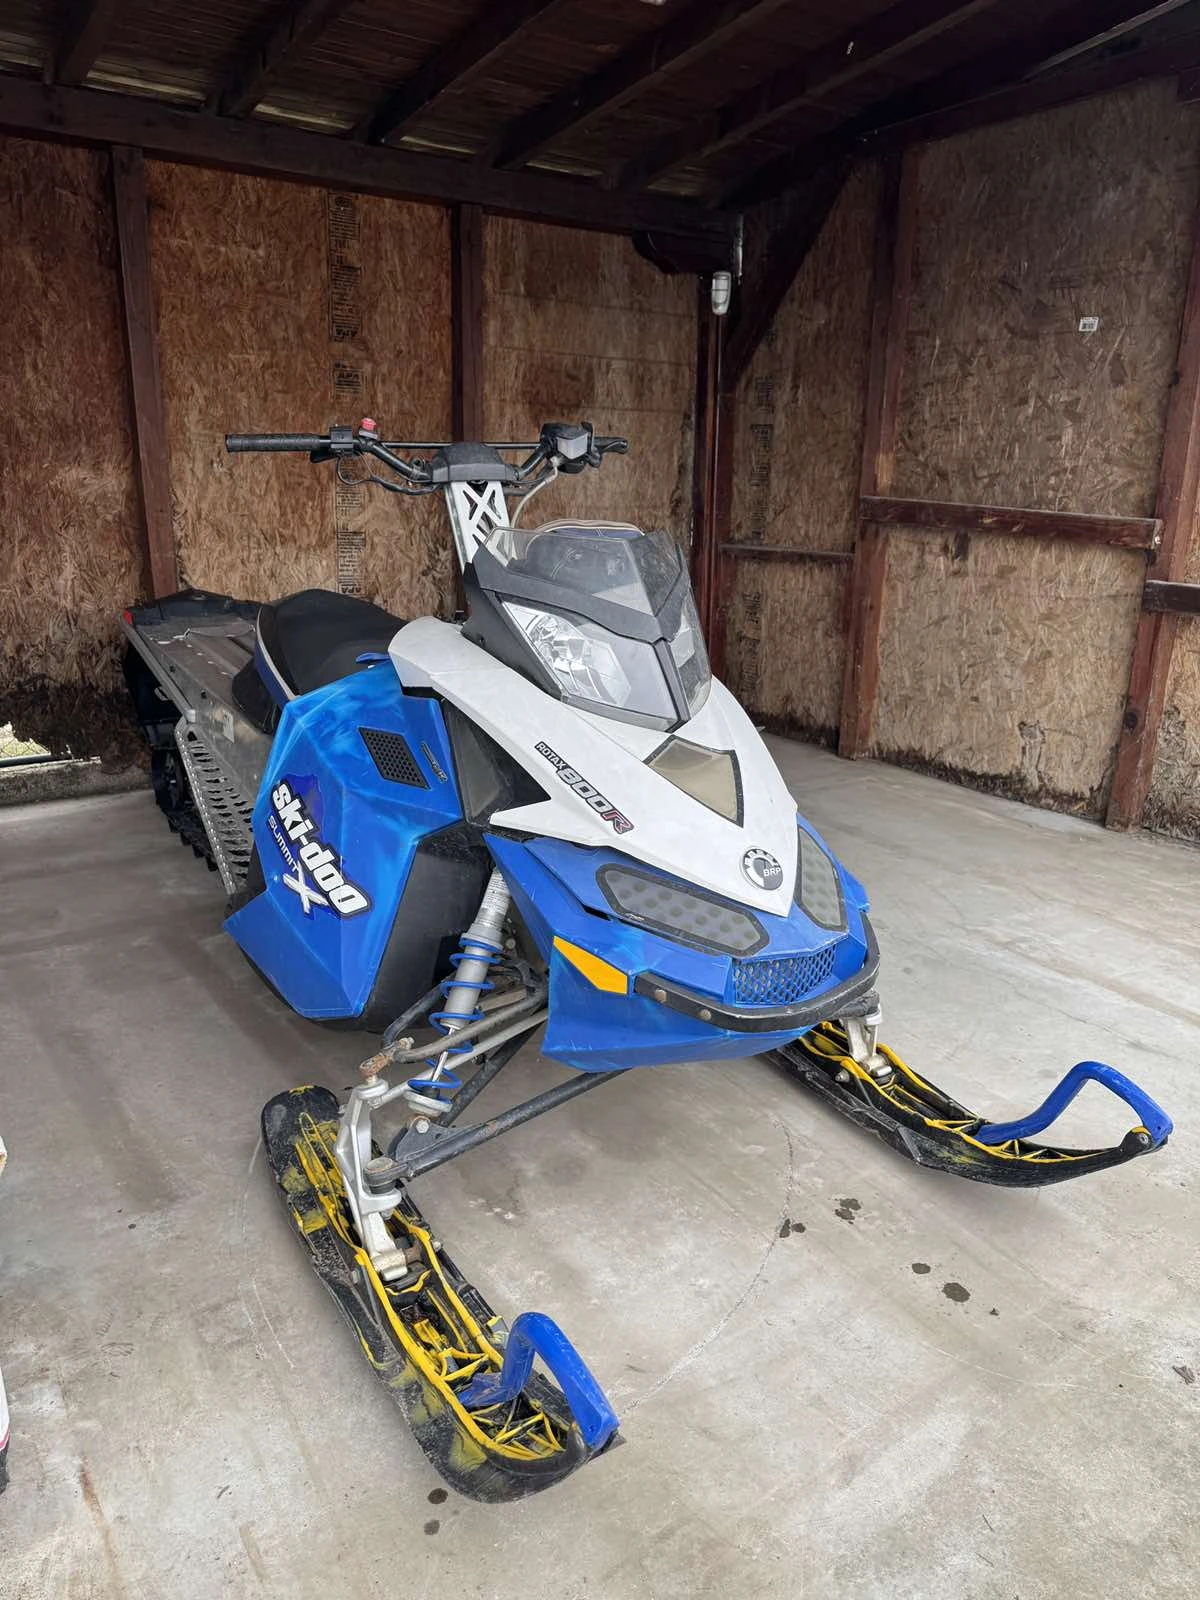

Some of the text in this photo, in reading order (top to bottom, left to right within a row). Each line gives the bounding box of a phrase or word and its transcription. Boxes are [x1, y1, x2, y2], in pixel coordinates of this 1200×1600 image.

[536, 742, 634, 834] ROTAX 800R
[268, 815, 298, 873] SUMMIT
[272, 783, 369, 915] ski-doo
[763, 867, 781, 877] BRP
